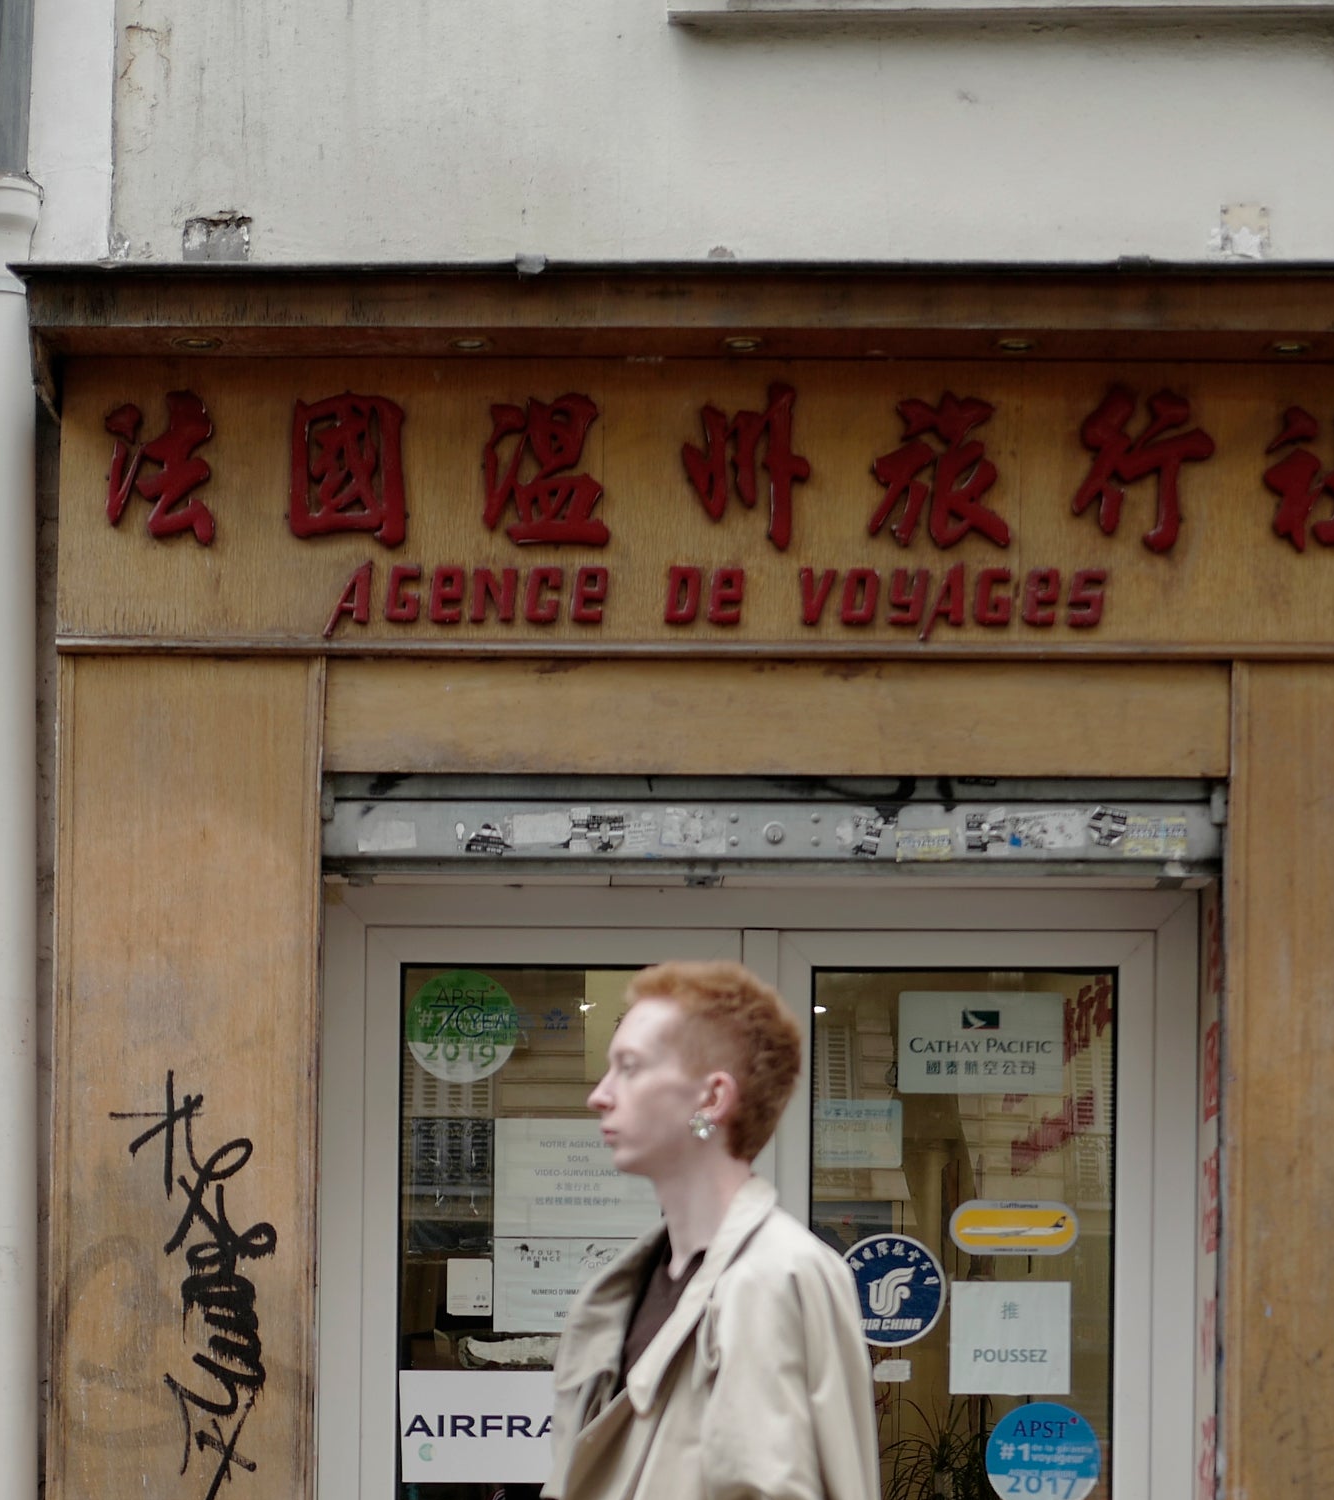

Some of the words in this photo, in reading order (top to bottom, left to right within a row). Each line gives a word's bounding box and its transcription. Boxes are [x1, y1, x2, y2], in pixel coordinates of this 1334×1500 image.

[323, 561, 609, 638] AGENCE
[665, 565, 744, 625] DE
[799, 563, 1108, 641] VOYAGES
[435, 987, 489, 1006] APST
[424, 1043, 497, 1068] 2019
[539, 1140, 566, 1149] NOTRE
[569, 1140, 601, 1149] AGENCE
[567, 1154, 589, 1163] SOUS
[1000, 1300, 1020, 1320] 推
[881, 1318, 923, 1331] CHINA
[973, 1348, 1048, 1363] POUSSEZ
[1012, 1420, 1068, 1438] APST
[1006, 1476, 1078, 1500] 2017
